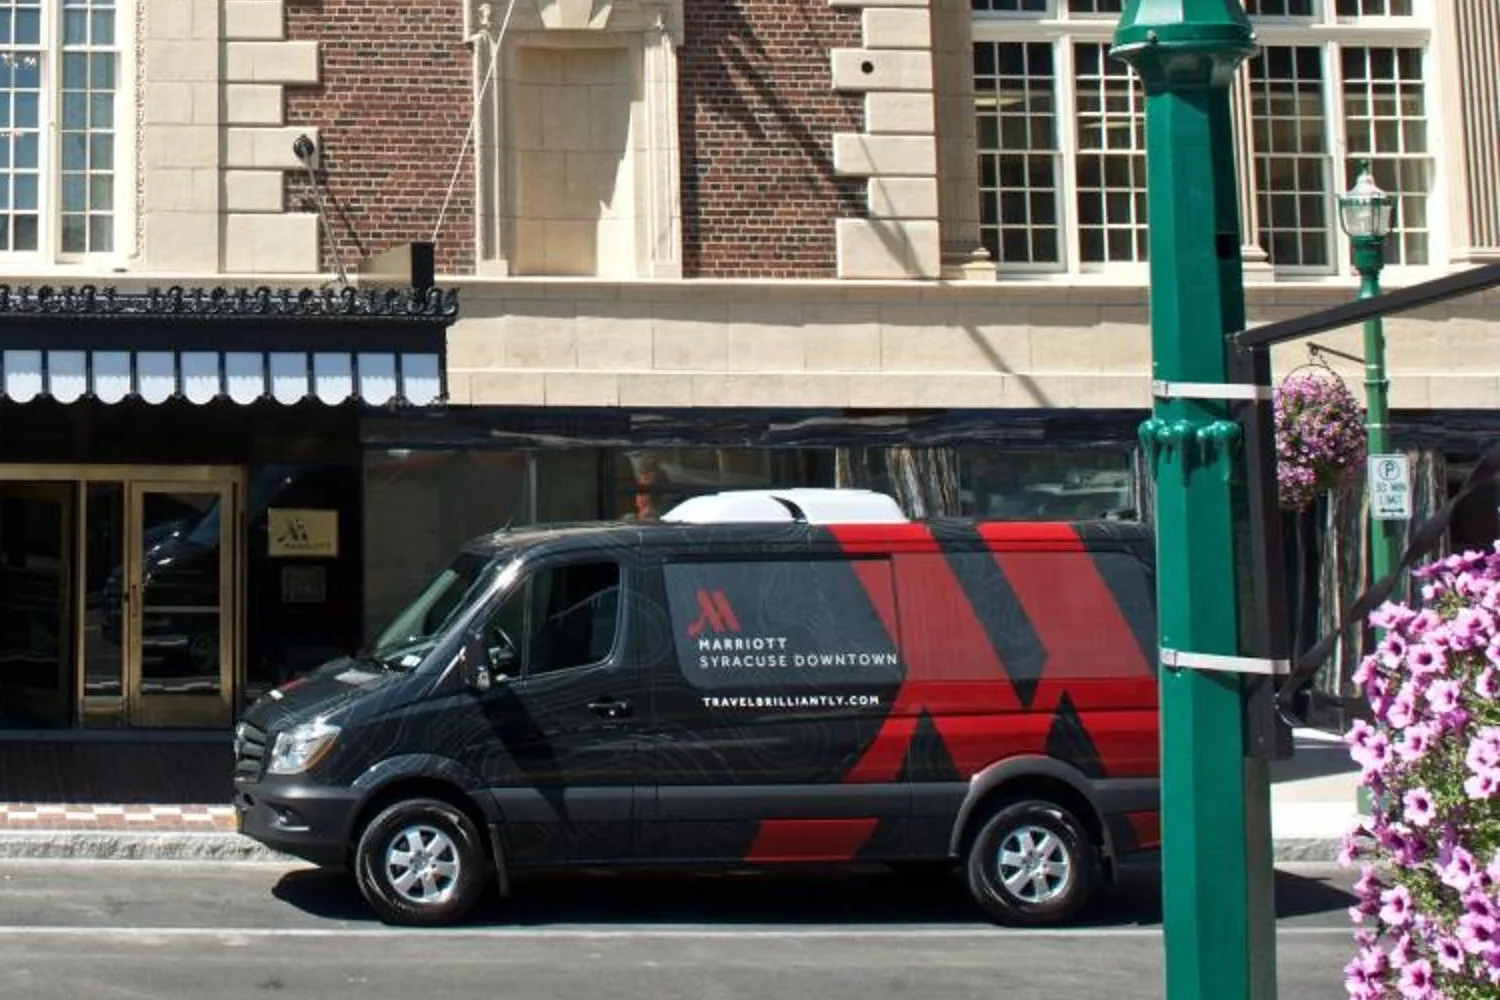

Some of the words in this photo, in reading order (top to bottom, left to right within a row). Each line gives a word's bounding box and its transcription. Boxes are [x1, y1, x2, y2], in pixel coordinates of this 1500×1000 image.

[699, 637, 787, 651] MARRIOTT
[699, 653, 788, 669] SYRACUSE
[794, 653, 898, 667] DOWNTOWN
[702, 694, 880, 708] TRAVELBRILLIANTLY.COM
